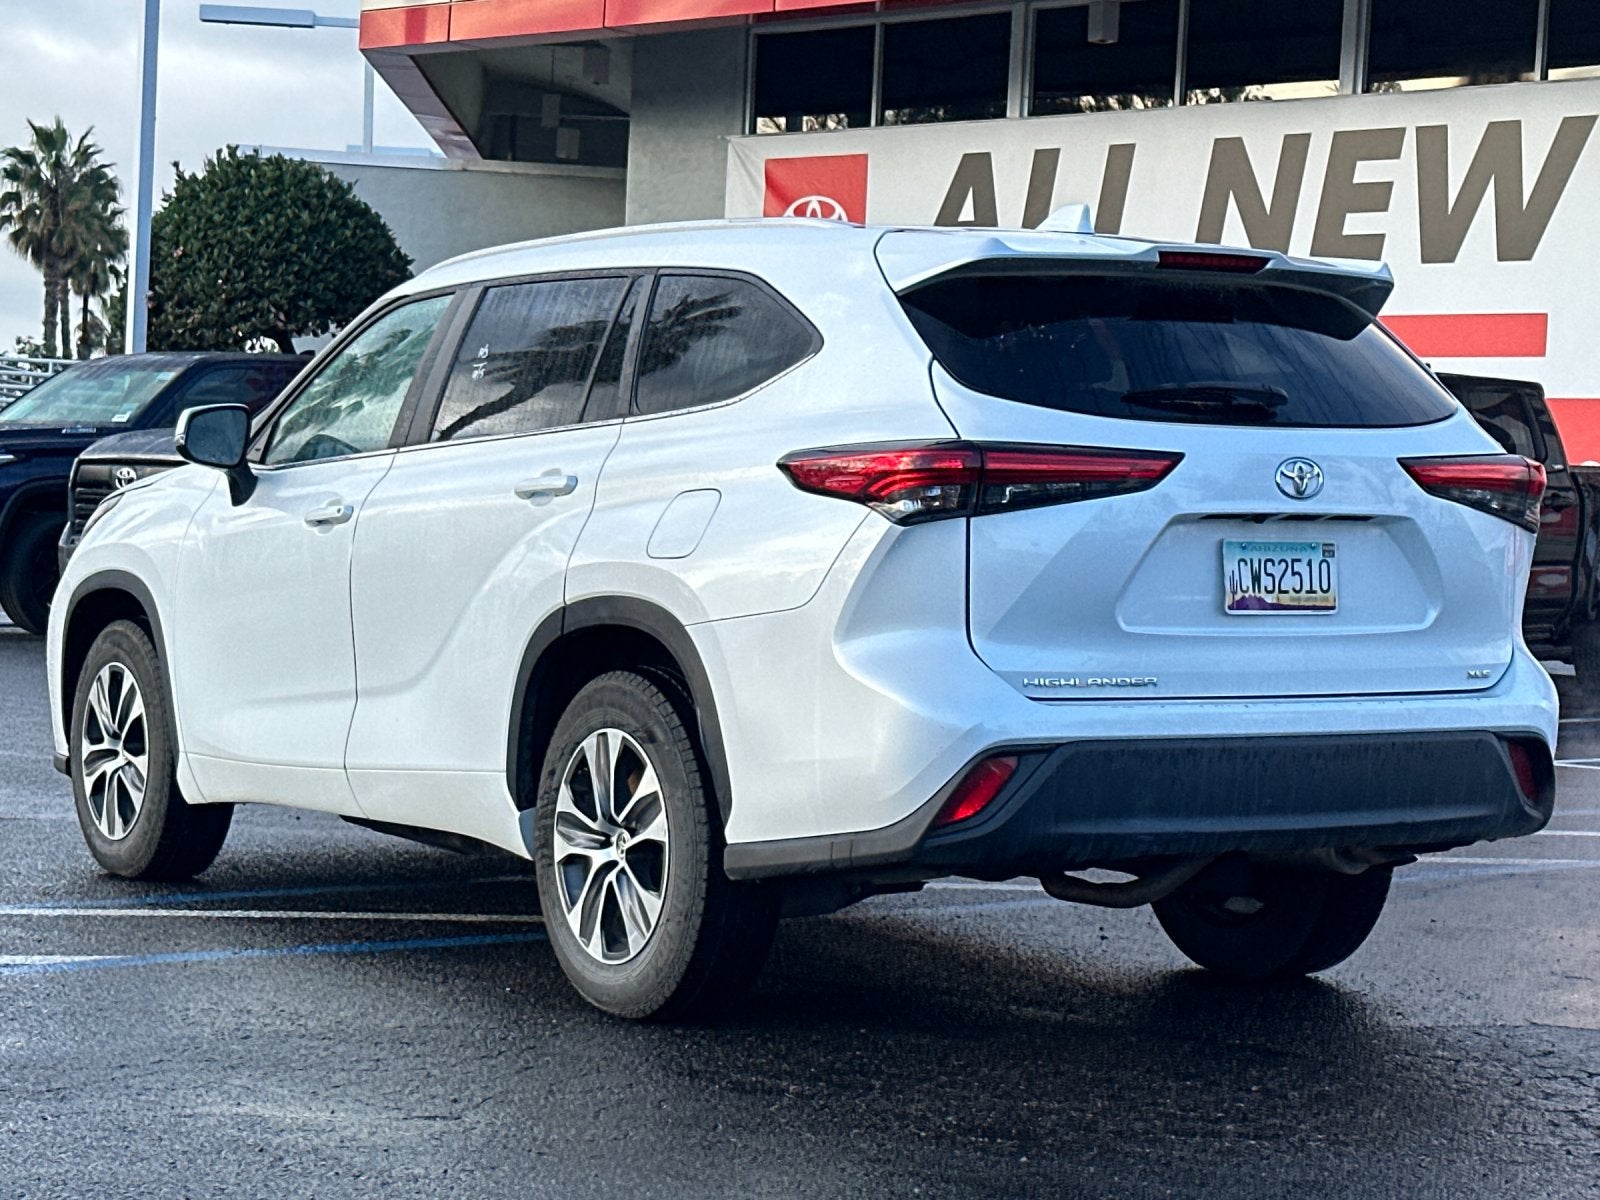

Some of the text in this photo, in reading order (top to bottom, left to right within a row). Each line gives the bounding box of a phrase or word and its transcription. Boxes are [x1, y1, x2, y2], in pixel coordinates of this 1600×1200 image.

[1195, 115, 1599, 264] NEW
[1249, 544, 1308, 553] ARIZONA
[1237, 557, 1331, 594] CWS2510
[1022, 677, 1158, 688] HIGHLANDER
